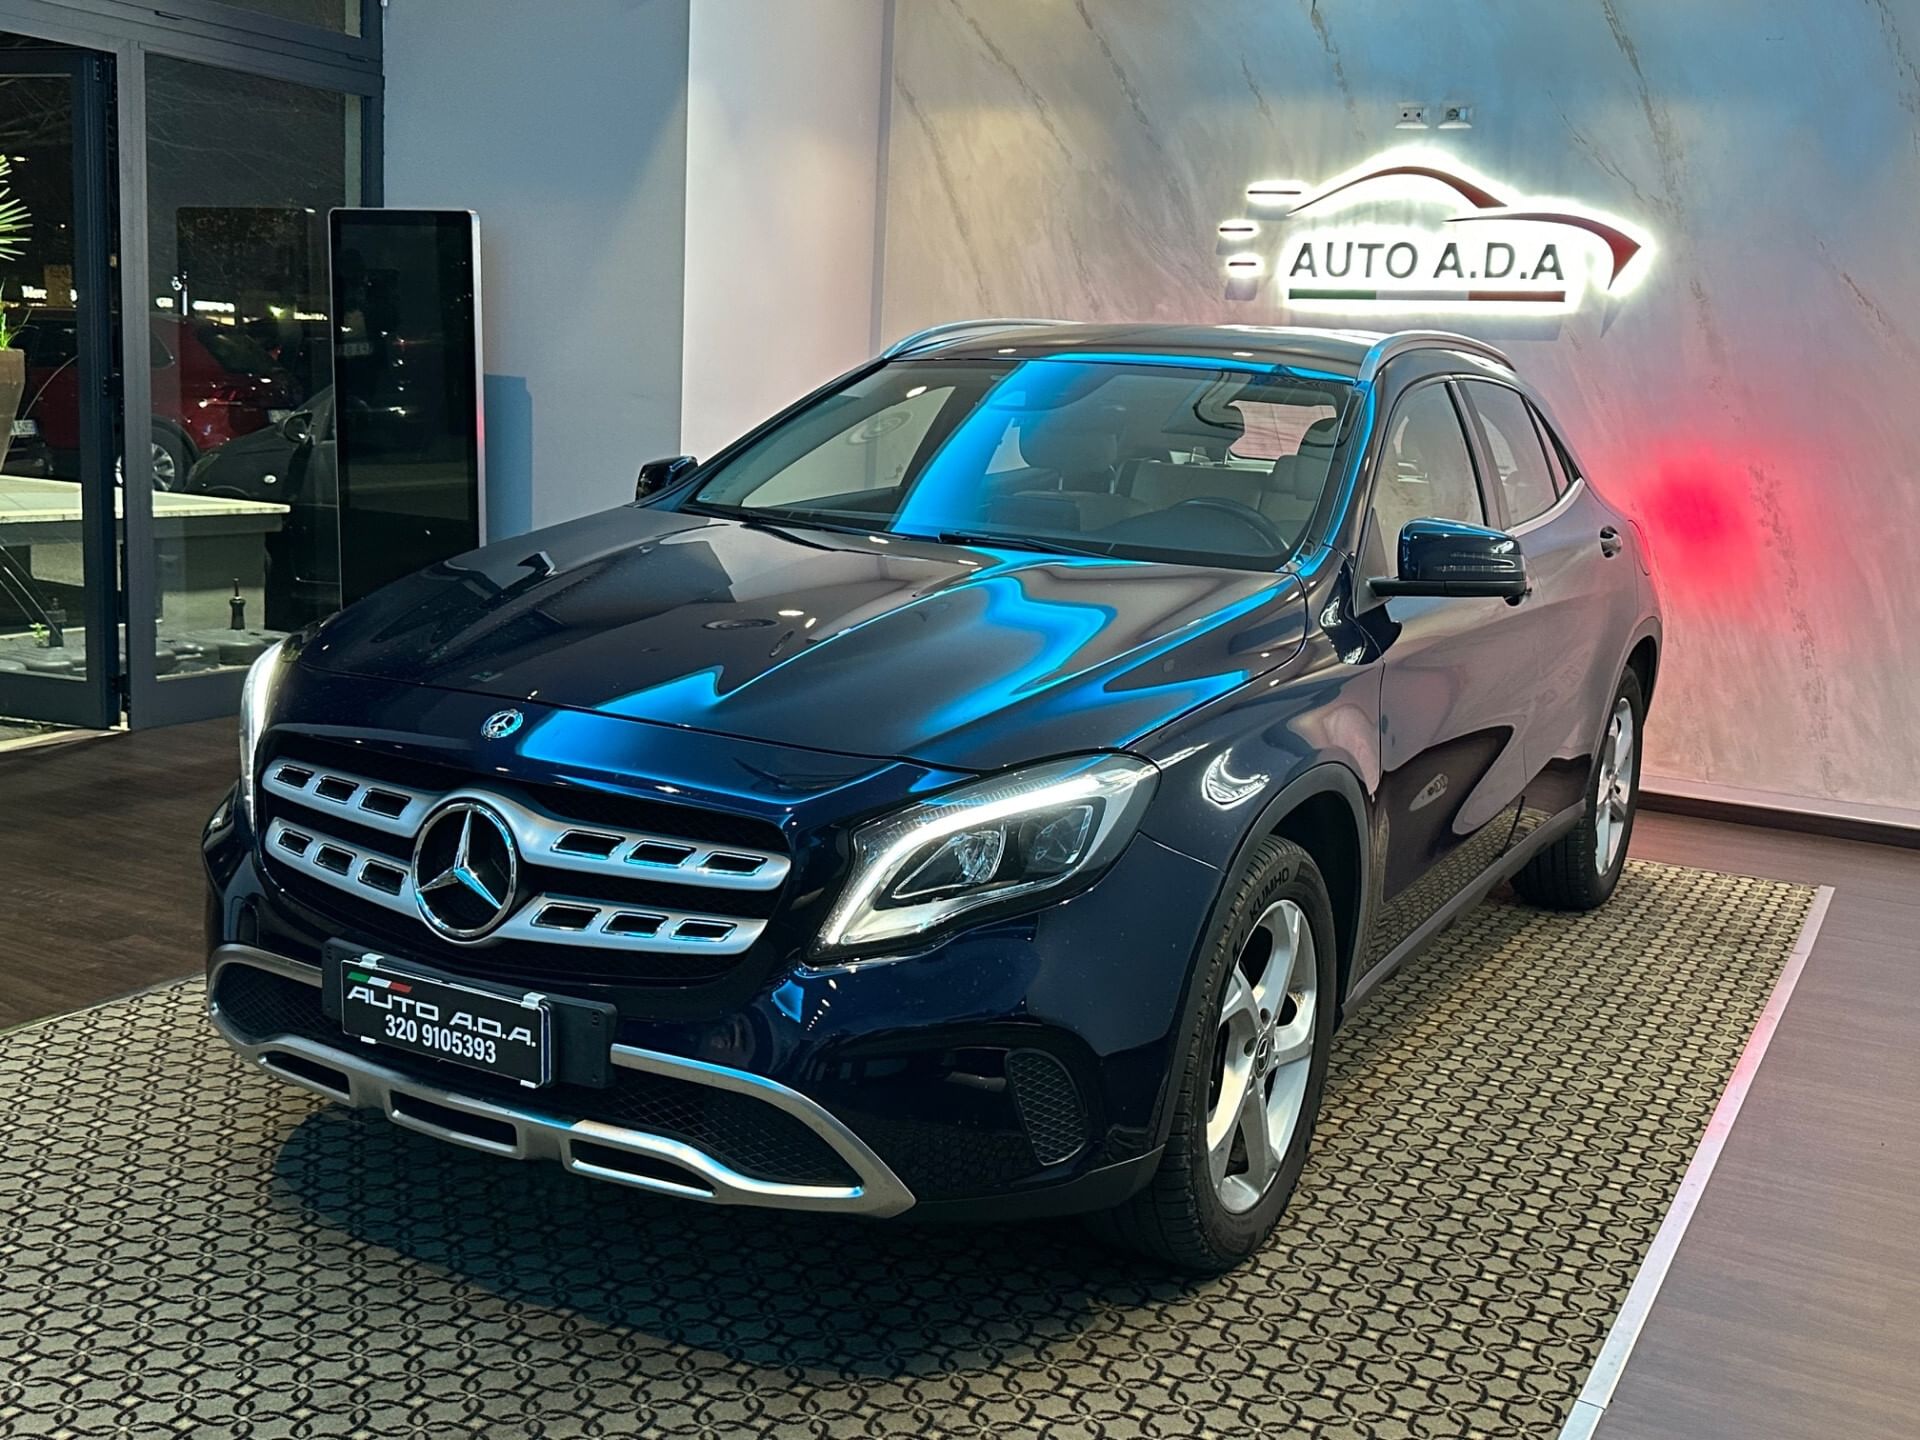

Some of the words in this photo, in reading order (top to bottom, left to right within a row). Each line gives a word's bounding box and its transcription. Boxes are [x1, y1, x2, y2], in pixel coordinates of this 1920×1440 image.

[1289, 242, 1418, 278] AUTO
[1433, 242, 1564, 280] A.D.A
[1250, 867, 1289, 920] KUMHO
[347, 986, 439, 1021] AUTO
[449, 1012, 536, 1047] A.D.A.
[385, 1014, 417, 1042] 320
[422, 1024, 496, 1063] 9105393
